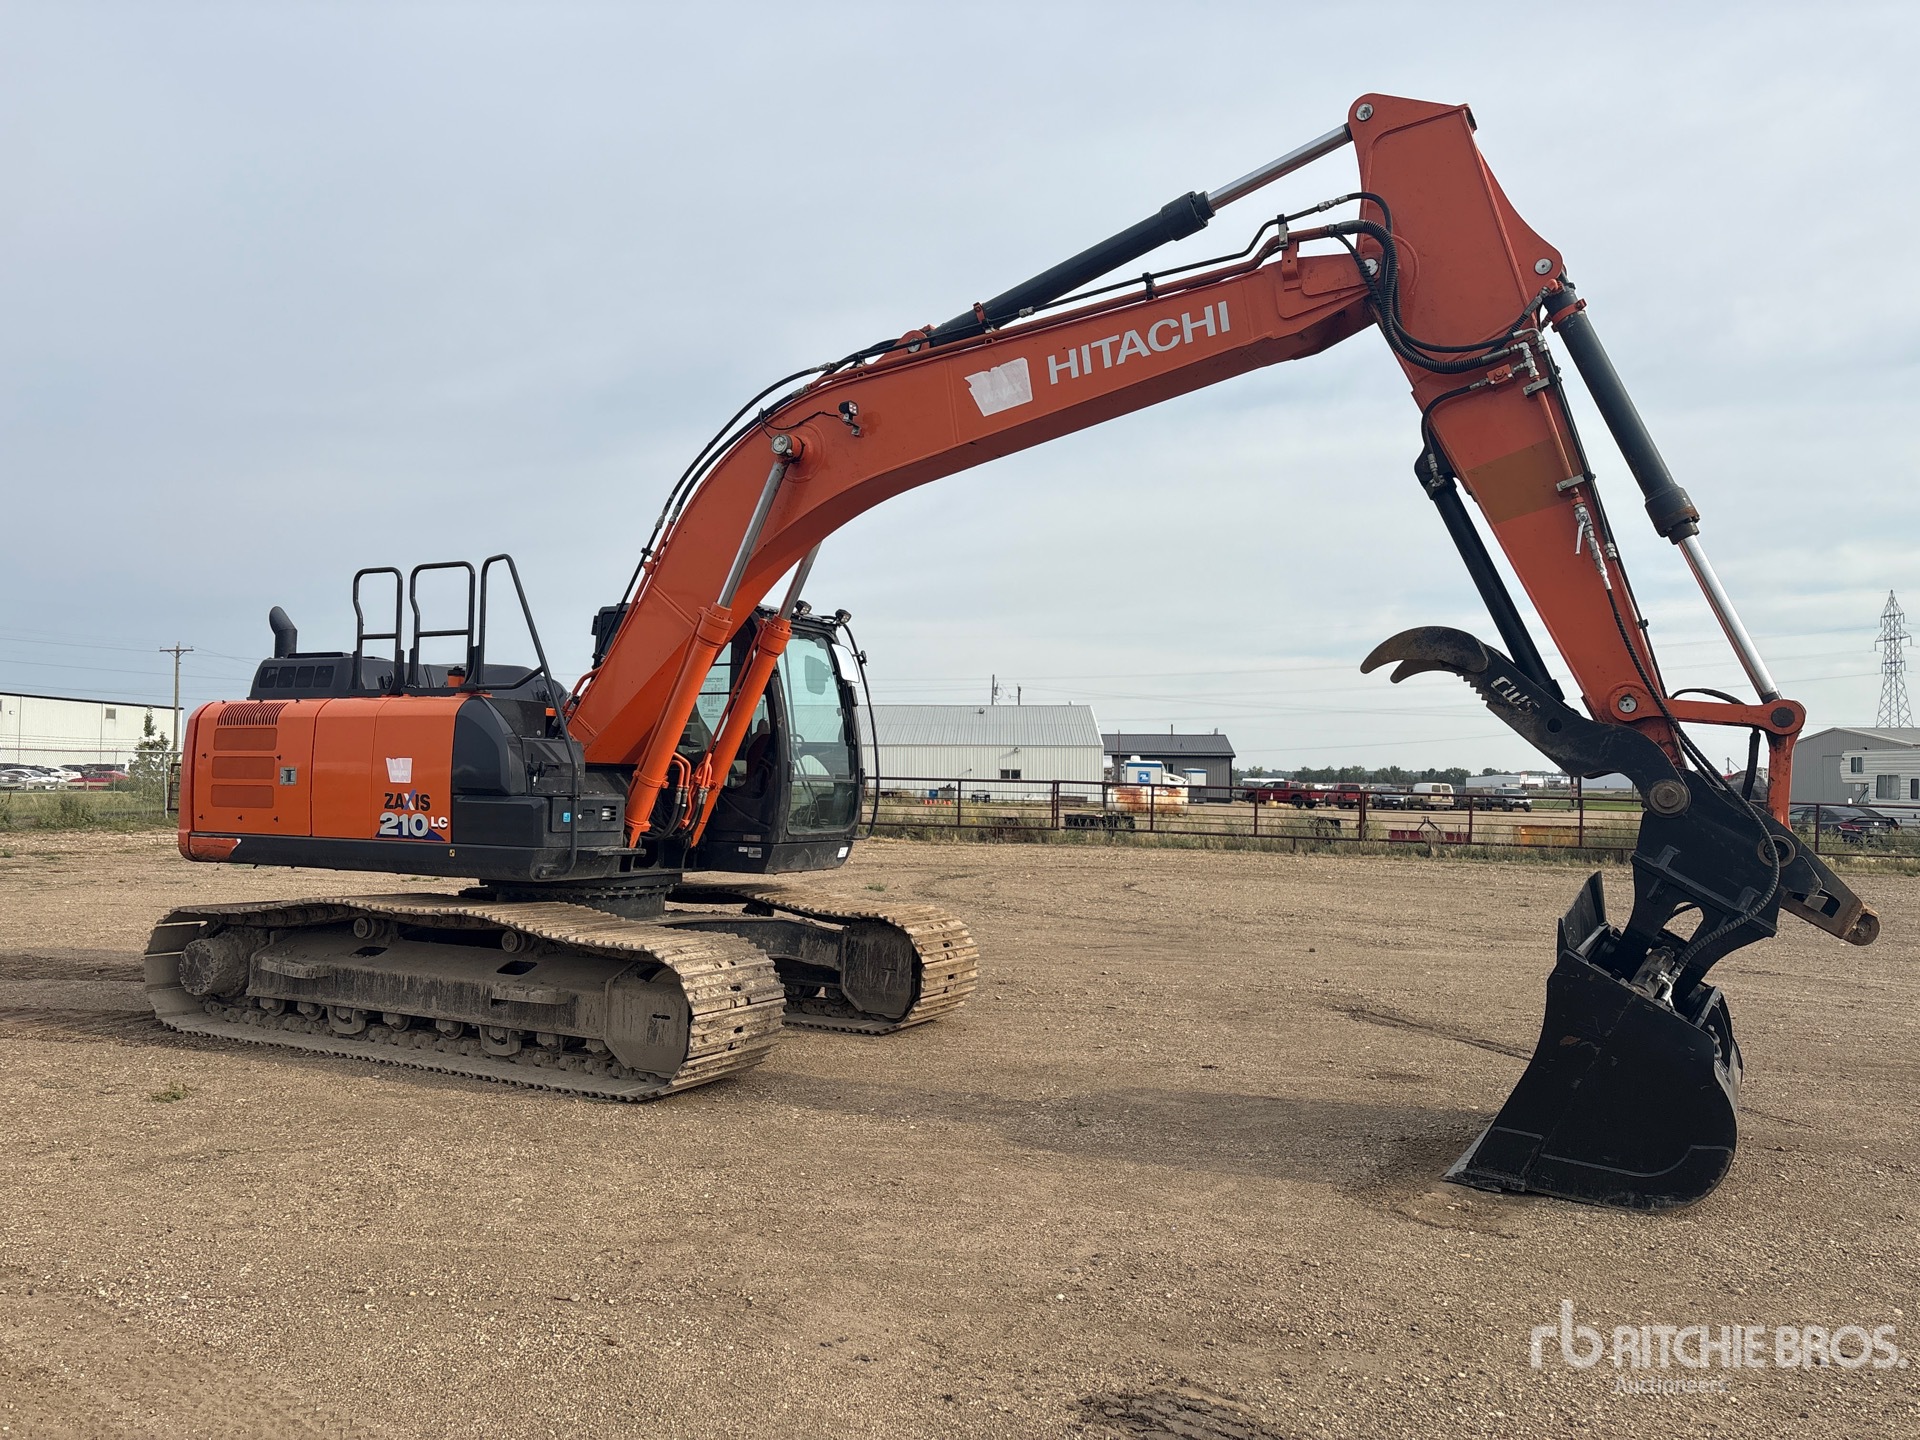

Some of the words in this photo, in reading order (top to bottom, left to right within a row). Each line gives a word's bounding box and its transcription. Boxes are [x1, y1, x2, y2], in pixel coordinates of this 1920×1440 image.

[1047, 301, 1231, 385] HITACHI
[384, 789, 431, 811] ZAXIS
[379, 812, 429, 837] 210
[430, 816, 448, 829] LC
